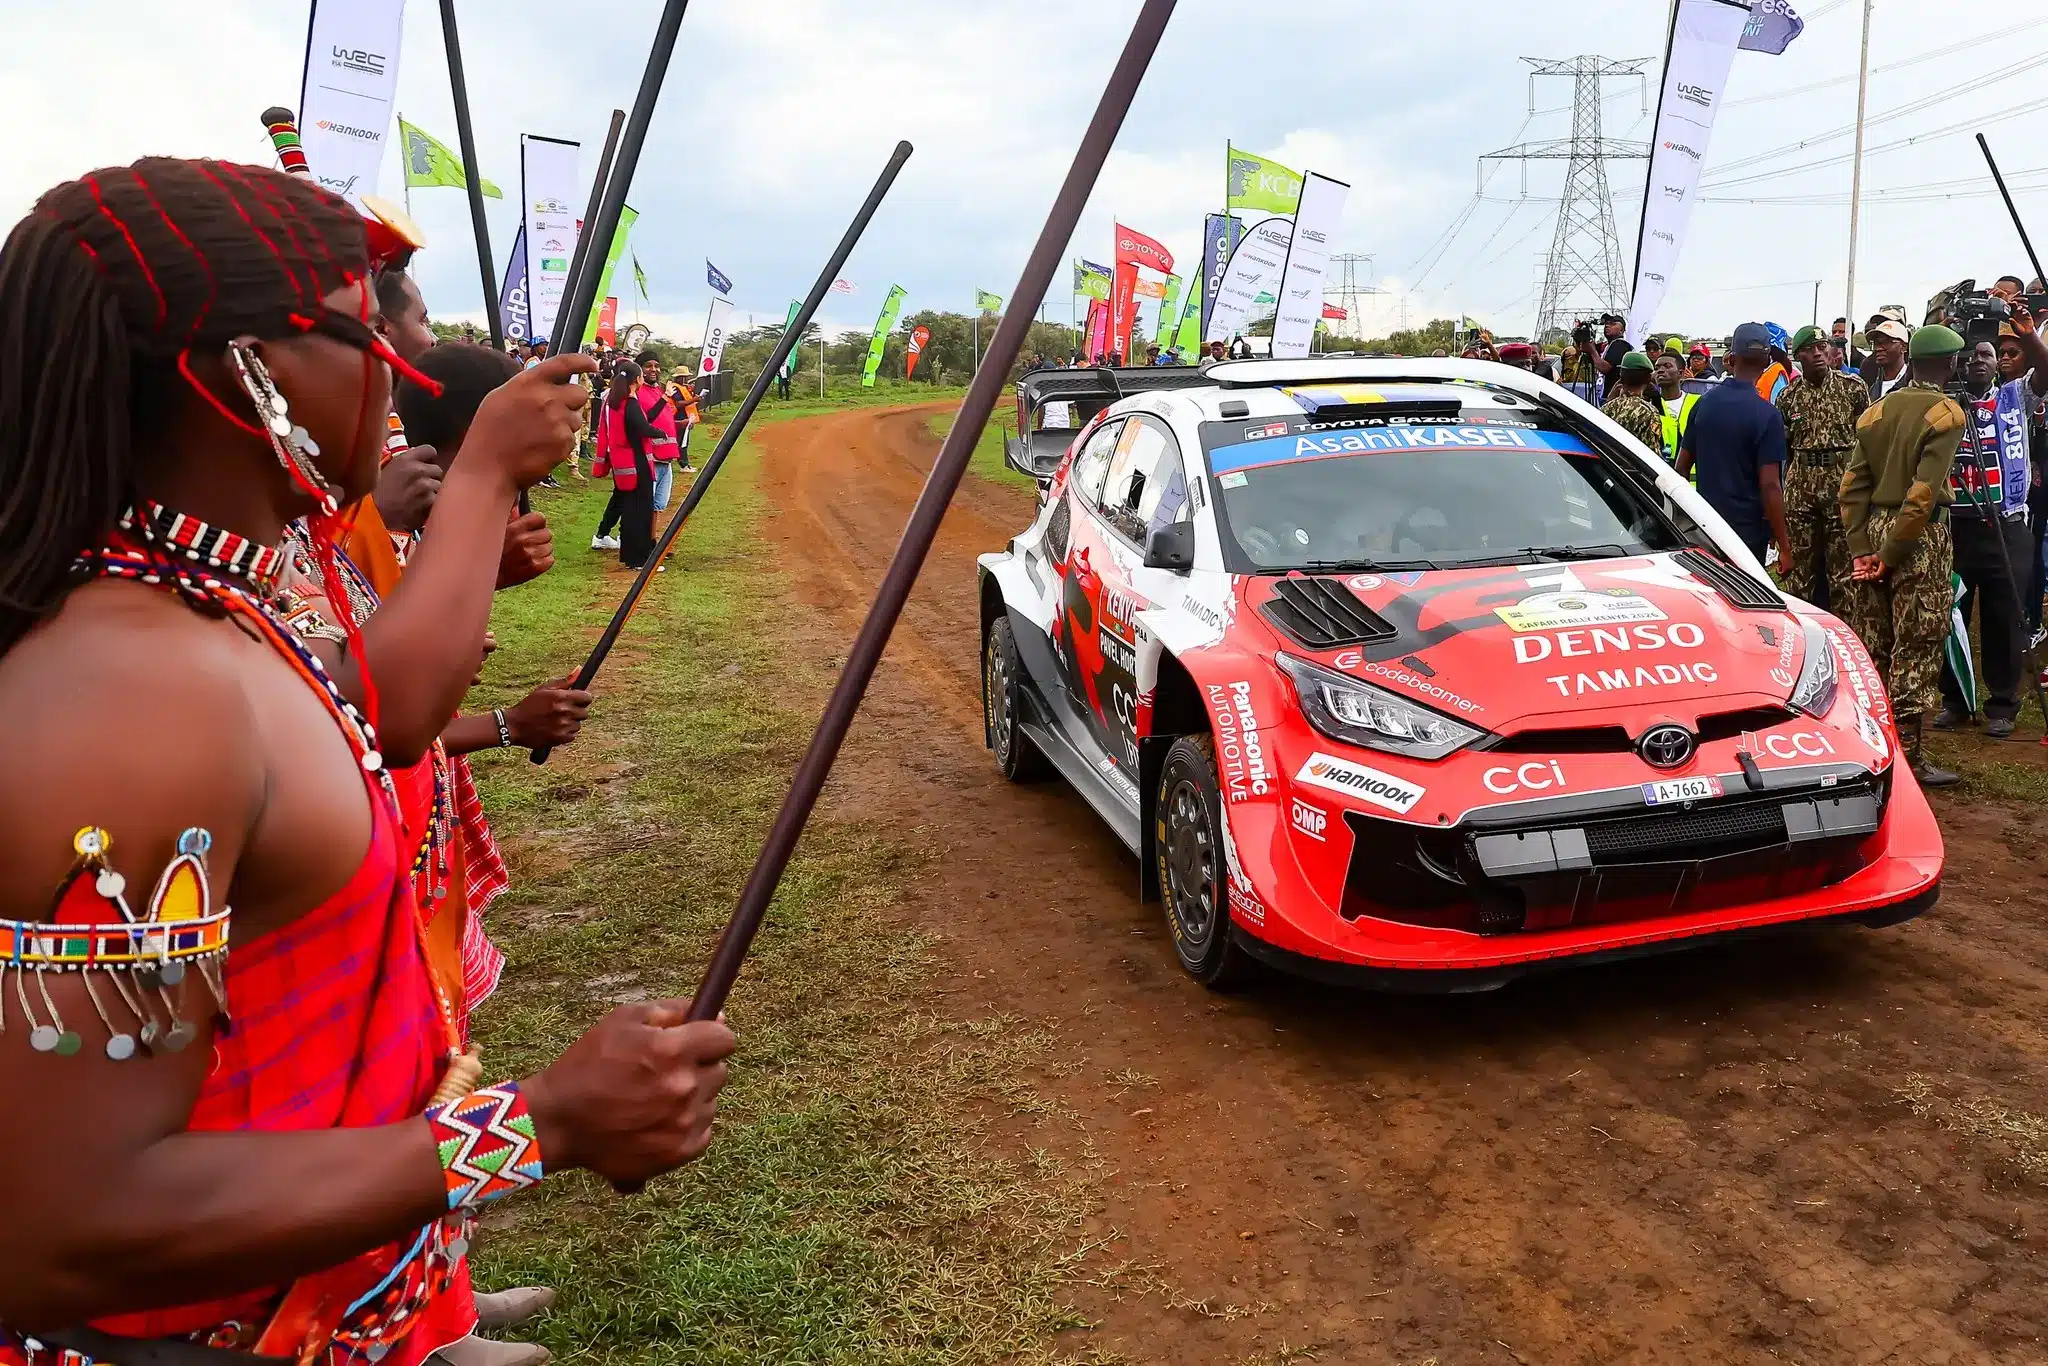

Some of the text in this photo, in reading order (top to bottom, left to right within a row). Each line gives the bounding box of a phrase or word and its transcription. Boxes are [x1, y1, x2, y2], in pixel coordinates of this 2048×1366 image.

[333, 45, 386, 68] WRC
[1677, 82, 1713, 101] WRC
[1259, 227, 1291, 245] WRC
[1302, 228, 1326, 241] WRC
[1135, 244, 1169, 266] TOYOTA
[708, 328, 721, 357] cfao
[1248, 416, 1538, 438] GR TOYOTA GAZOO Racing
[2001, 408, 2024, 460] 804
[1106, 587, 1136, 628] KENYA
[1181, 594, 1219, 628] TAMADIC
[1518, 619, 1559, 629] SAFARI
[1561, 615, 1591, 625] RALLY
[1594, 613, 1630, 622] KENYA
[1100, 631, 1119, 665] PAVEL
[1511, 622, 1706, 664] DENSO
[1364, 660, 1481, 714] codebeamer
[1546, 662, 1718, 697] TAMADIC
[1206, 684, 1248, 802] AUTOMOTIVE
[1228, 680, 1269, 796] Panasonic
[1660, 781, 1707, 800] A-7662
[1291, 803, 1327, 834] OMP
